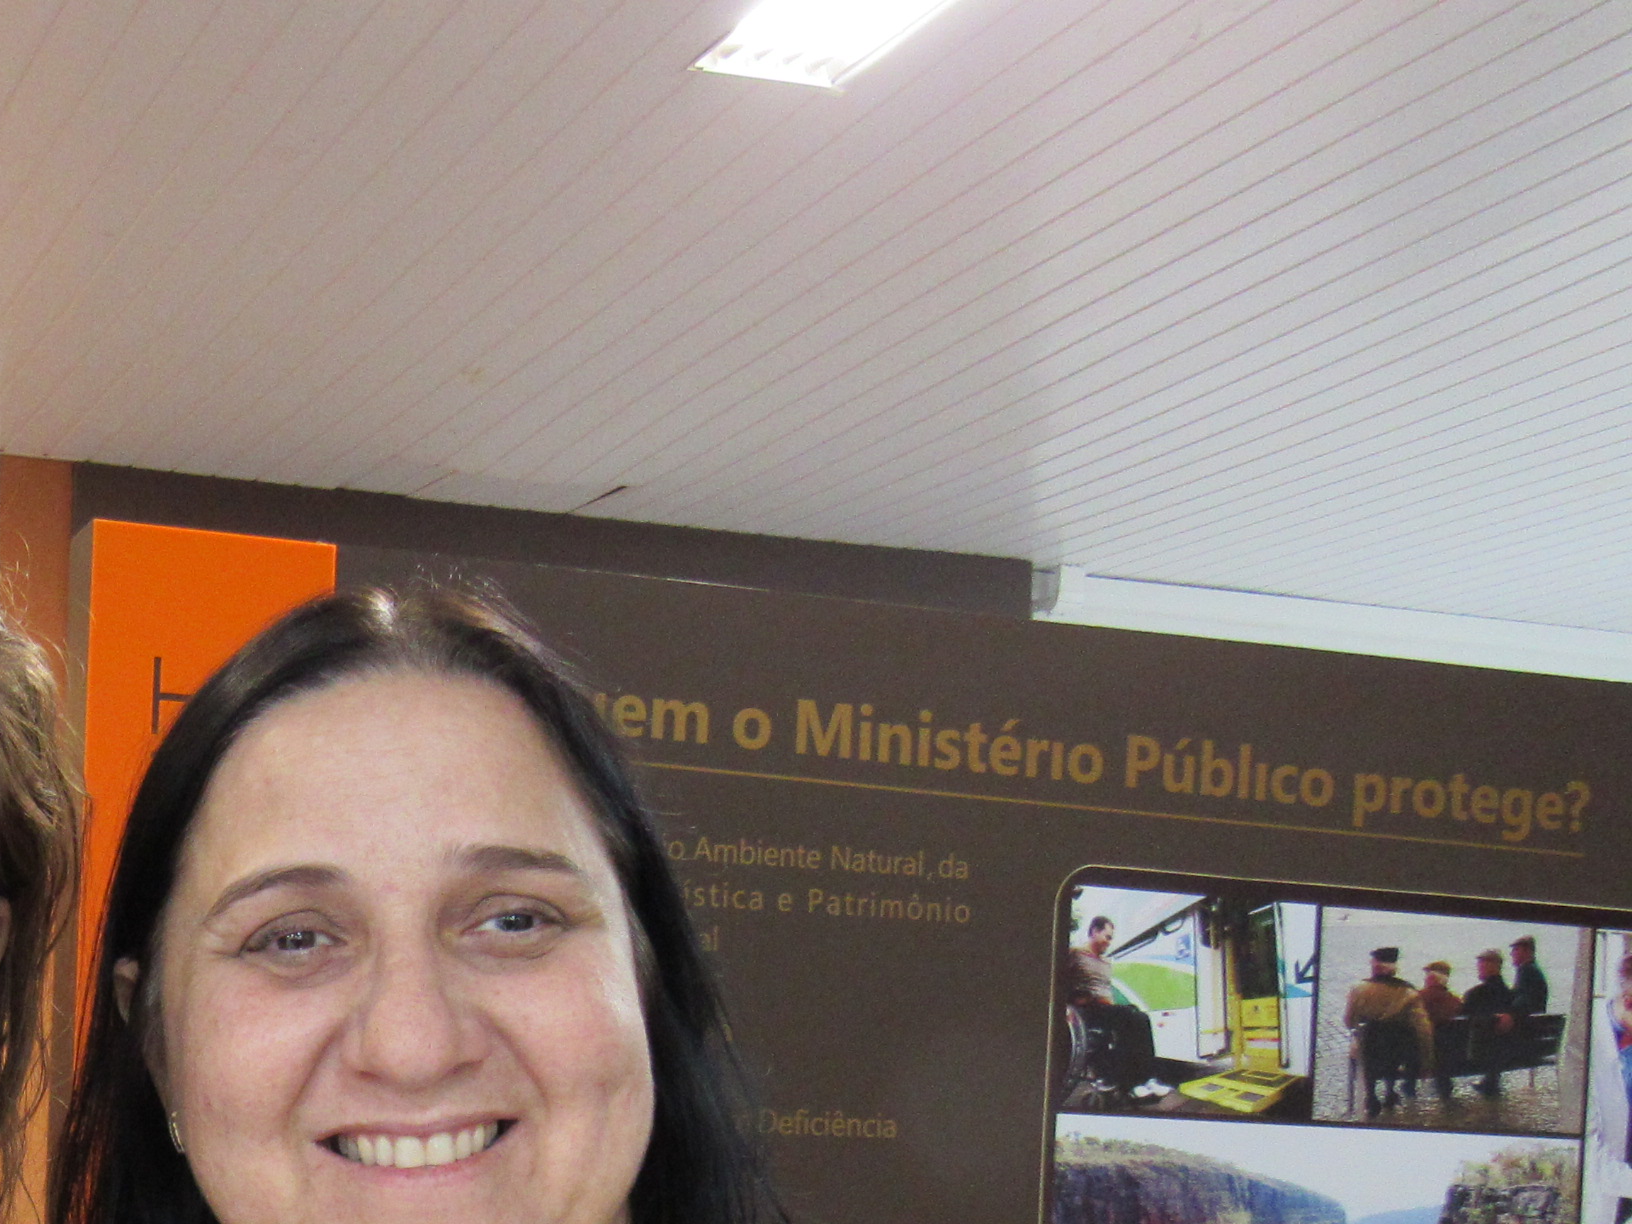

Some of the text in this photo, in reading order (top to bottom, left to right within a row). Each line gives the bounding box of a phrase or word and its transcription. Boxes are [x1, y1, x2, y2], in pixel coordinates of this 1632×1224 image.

[732, 706, 772, 750] o
[795, 698, 1105, 784] Ministério
[1124, 734, 1335, 807] Público
[1351, 771, 1590, 842] protege?
[694, 837, 821, 869] Ambiente
[938, 853, 969, 880] da
[680, 879, 970, 923] ística e Patrimônio
[760, 1108, 898, 1139] Deficiência
